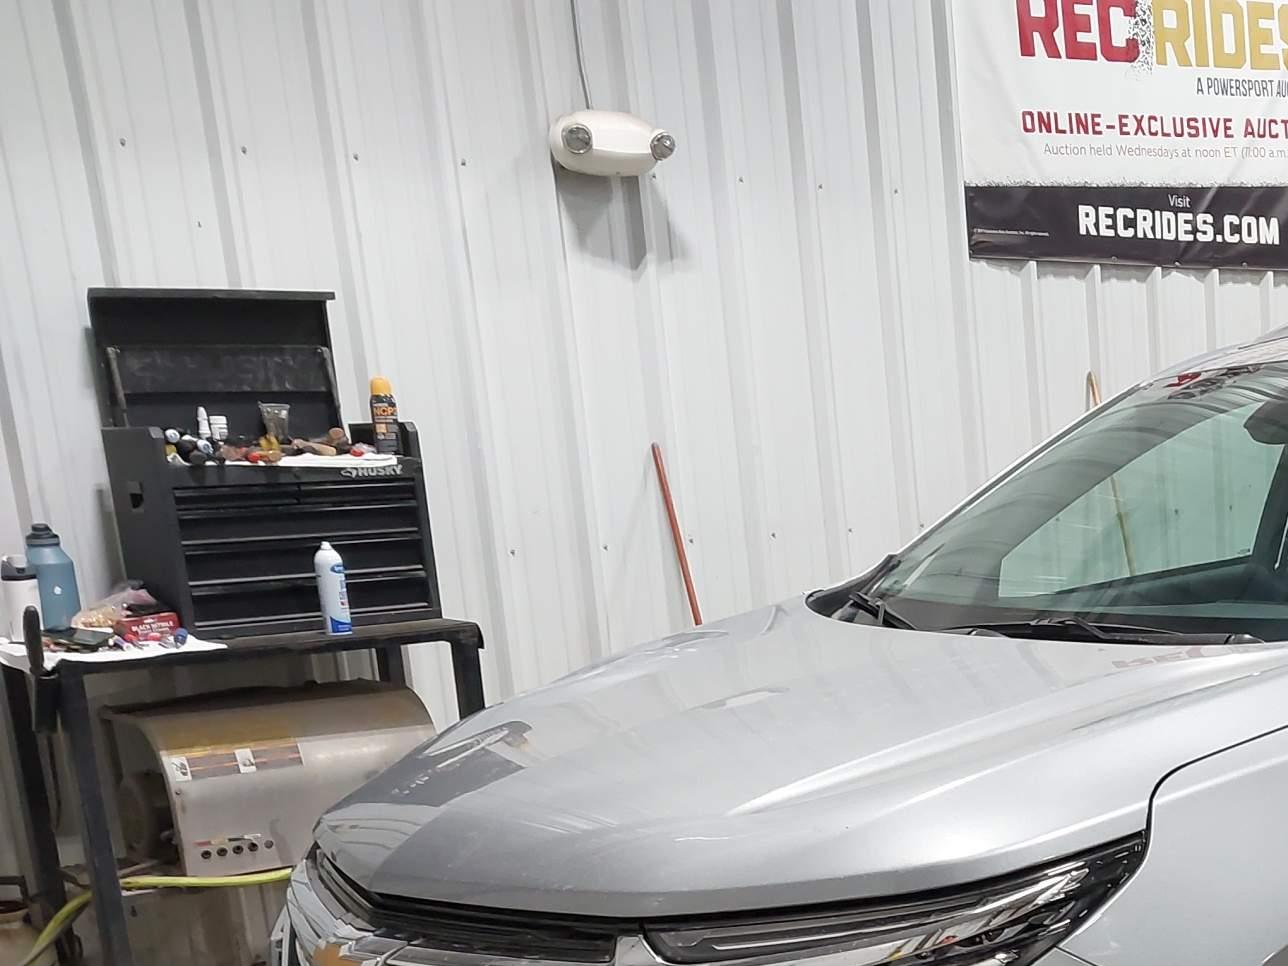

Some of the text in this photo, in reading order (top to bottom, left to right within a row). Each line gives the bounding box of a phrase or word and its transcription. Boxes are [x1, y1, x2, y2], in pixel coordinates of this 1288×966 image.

[1196, 77, 1205, 95] A
[1206, 77, 1275, 97] POWERSPORT
[1021, 110, 1234, 139] ONLINE-EXCLUSIVE
[1044, 143, 1086, 156] Auction
[1089, 143, 1113, 156] held
[1115, 145, 1179, 160] Wednesdays
[1181, 147, 1192, 158] at
[1195, 147, 1221, 158] noon
[1224, 147, 1237, 158] ET
[1167, 194, 1191, 209] Visit
[1078, 204, 1281, 245] RECRIDES.COM
[358, 463, 403, 477] HUSKY
